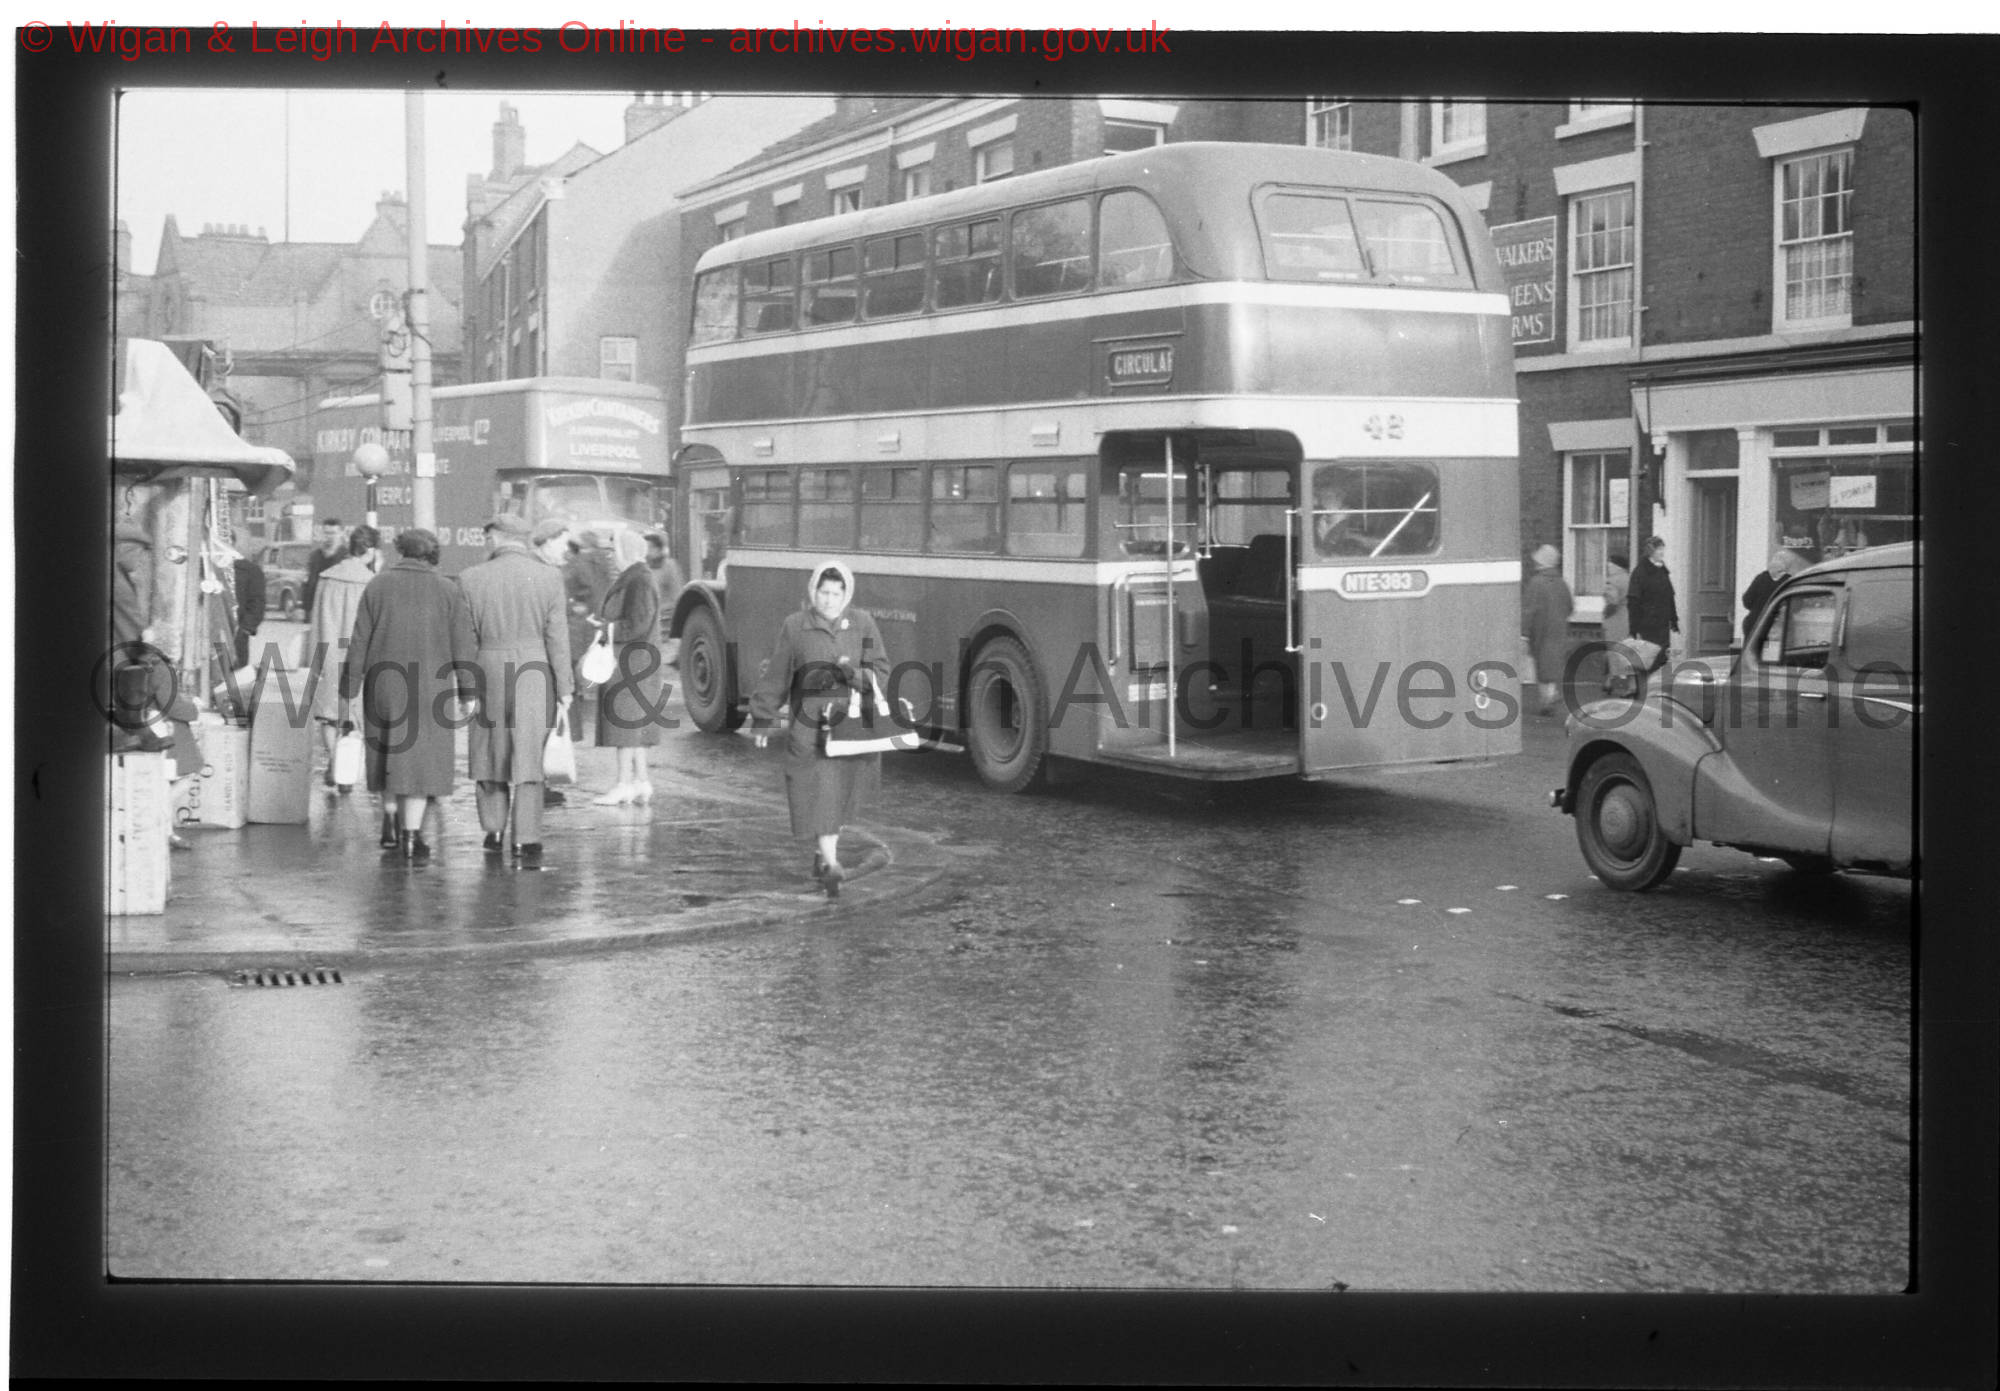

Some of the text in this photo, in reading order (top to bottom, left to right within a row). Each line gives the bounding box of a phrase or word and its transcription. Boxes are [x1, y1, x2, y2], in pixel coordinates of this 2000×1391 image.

[1511, 281, 1553, 307] EENS
[1511, 313, 1544, 338] RMS
[569, 443, 641, 459] LIVERPOOL
[456, 526, 485, 547] CASES
